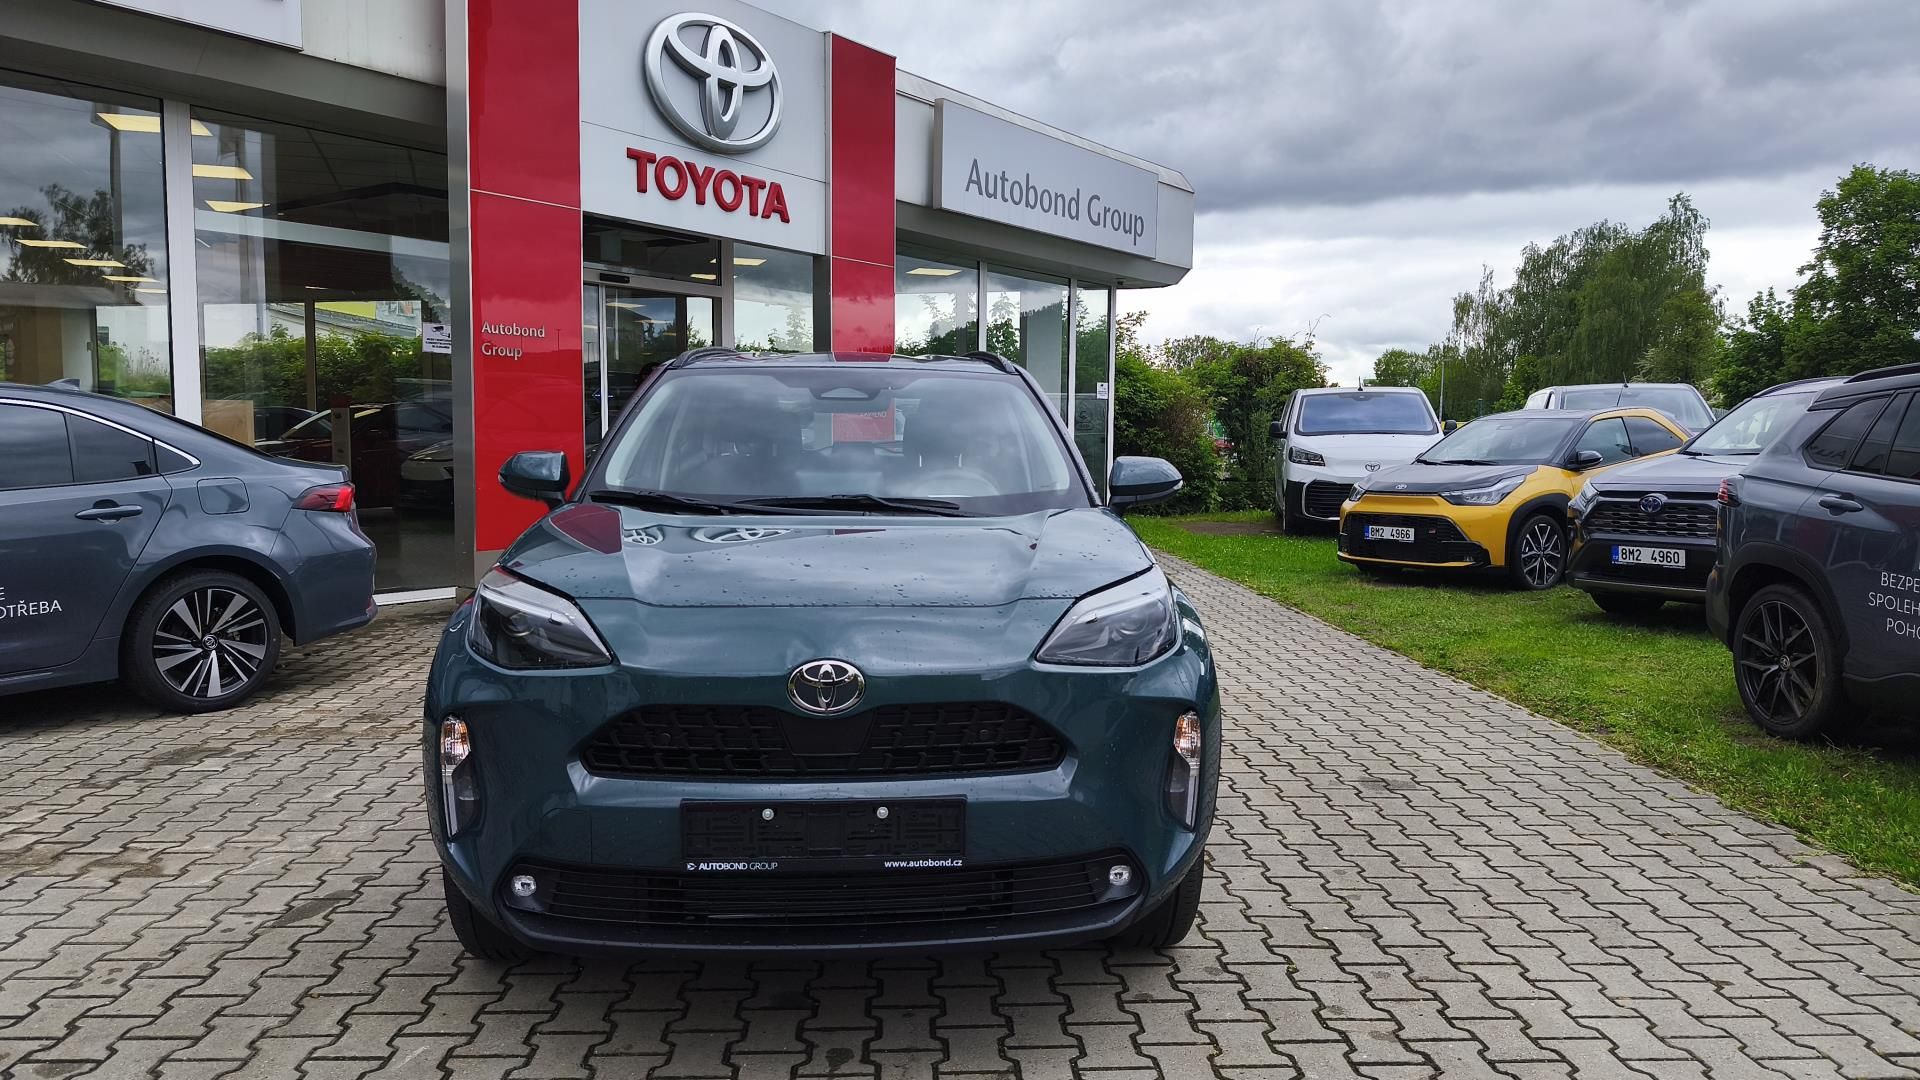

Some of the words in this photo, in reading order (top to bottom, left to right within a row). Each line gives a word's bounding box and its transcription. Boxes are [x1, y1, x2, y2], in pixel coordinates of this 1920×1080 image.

[627, 147, 790, 223] TOYOTA
[965, 158, 1080, 221] Autobond
[1087, 194, 1144, 246] Group
[481, 321, 545, 338] Autobond
[481, 342, 522, 360] Group
[1370, 527, 1385, 538] 8M2
[1390, 528, 1411, 540] 4966
[1621, 547, 1642, 561] 8M2
[1650, 549, 1680, 564] 4960
[1881, 571, 1920, 593] BEZPE
[698, 862, 748, 870] AUTOBOND
[749, 861, 778, 870] GROUP
[884, 859, 962, 867] www.autobond.cz
